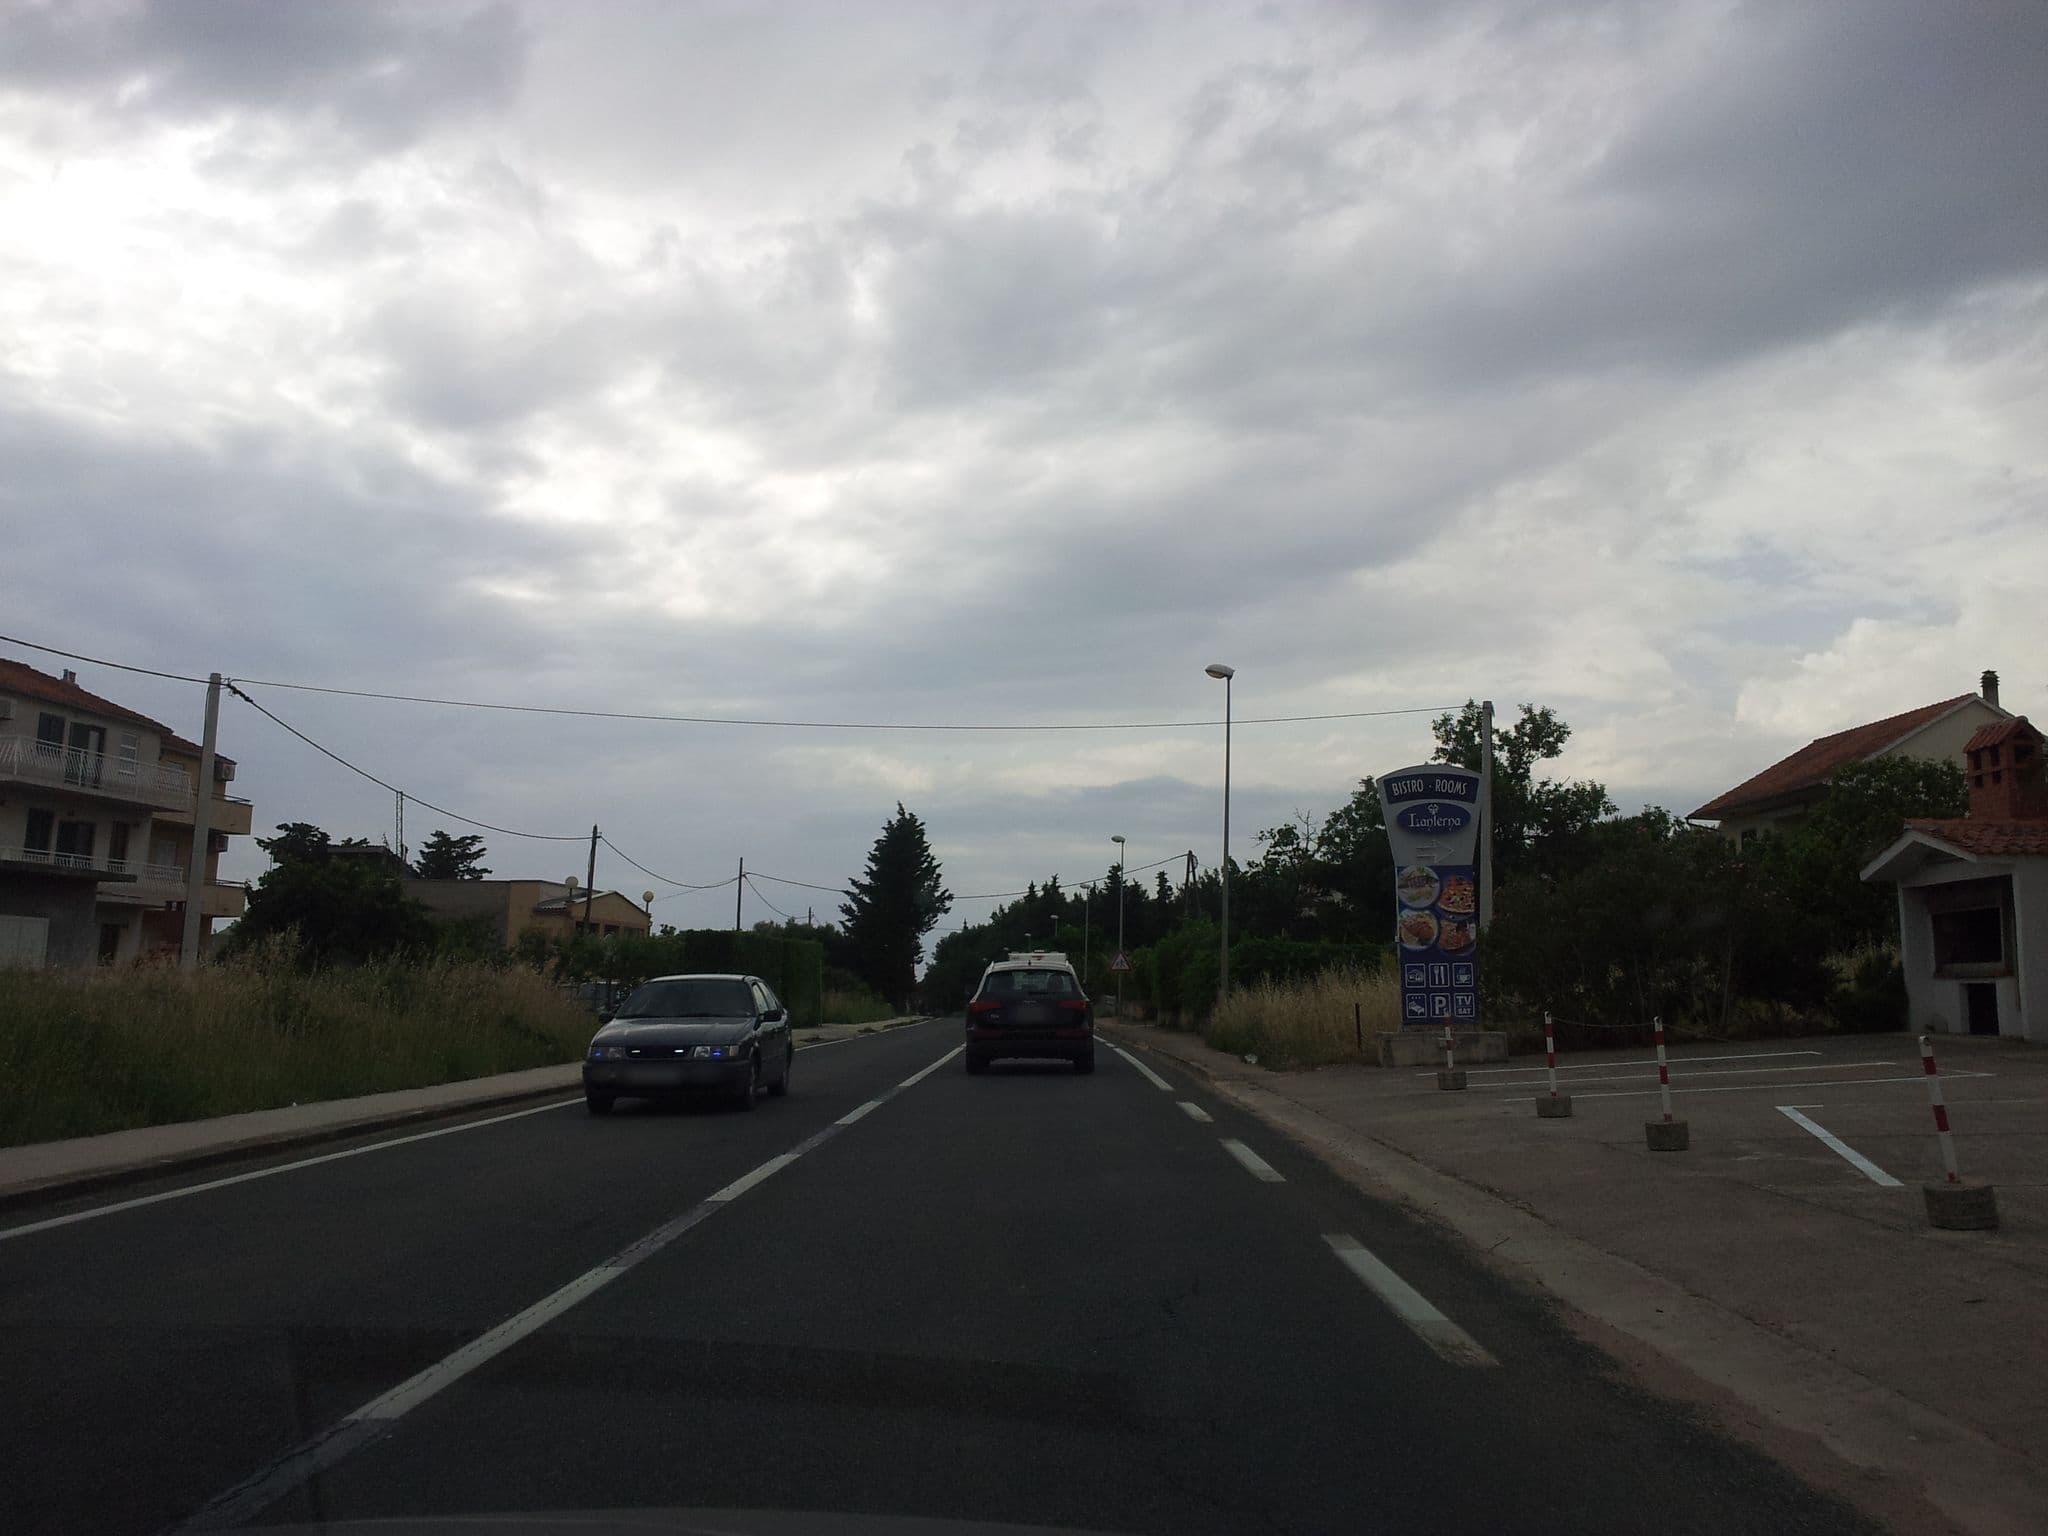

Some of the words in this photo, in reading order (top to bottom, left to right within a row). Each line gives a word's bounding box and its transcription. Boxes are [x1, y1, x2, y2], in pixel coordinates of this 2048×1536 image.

[1391, 779, 1424, 795] BISTRO
[1435, 779, 1468, 795] ROOMS
[1408, 813, 1461, 831] Lanterna
[1456, 995, 1472, 1005] TV
